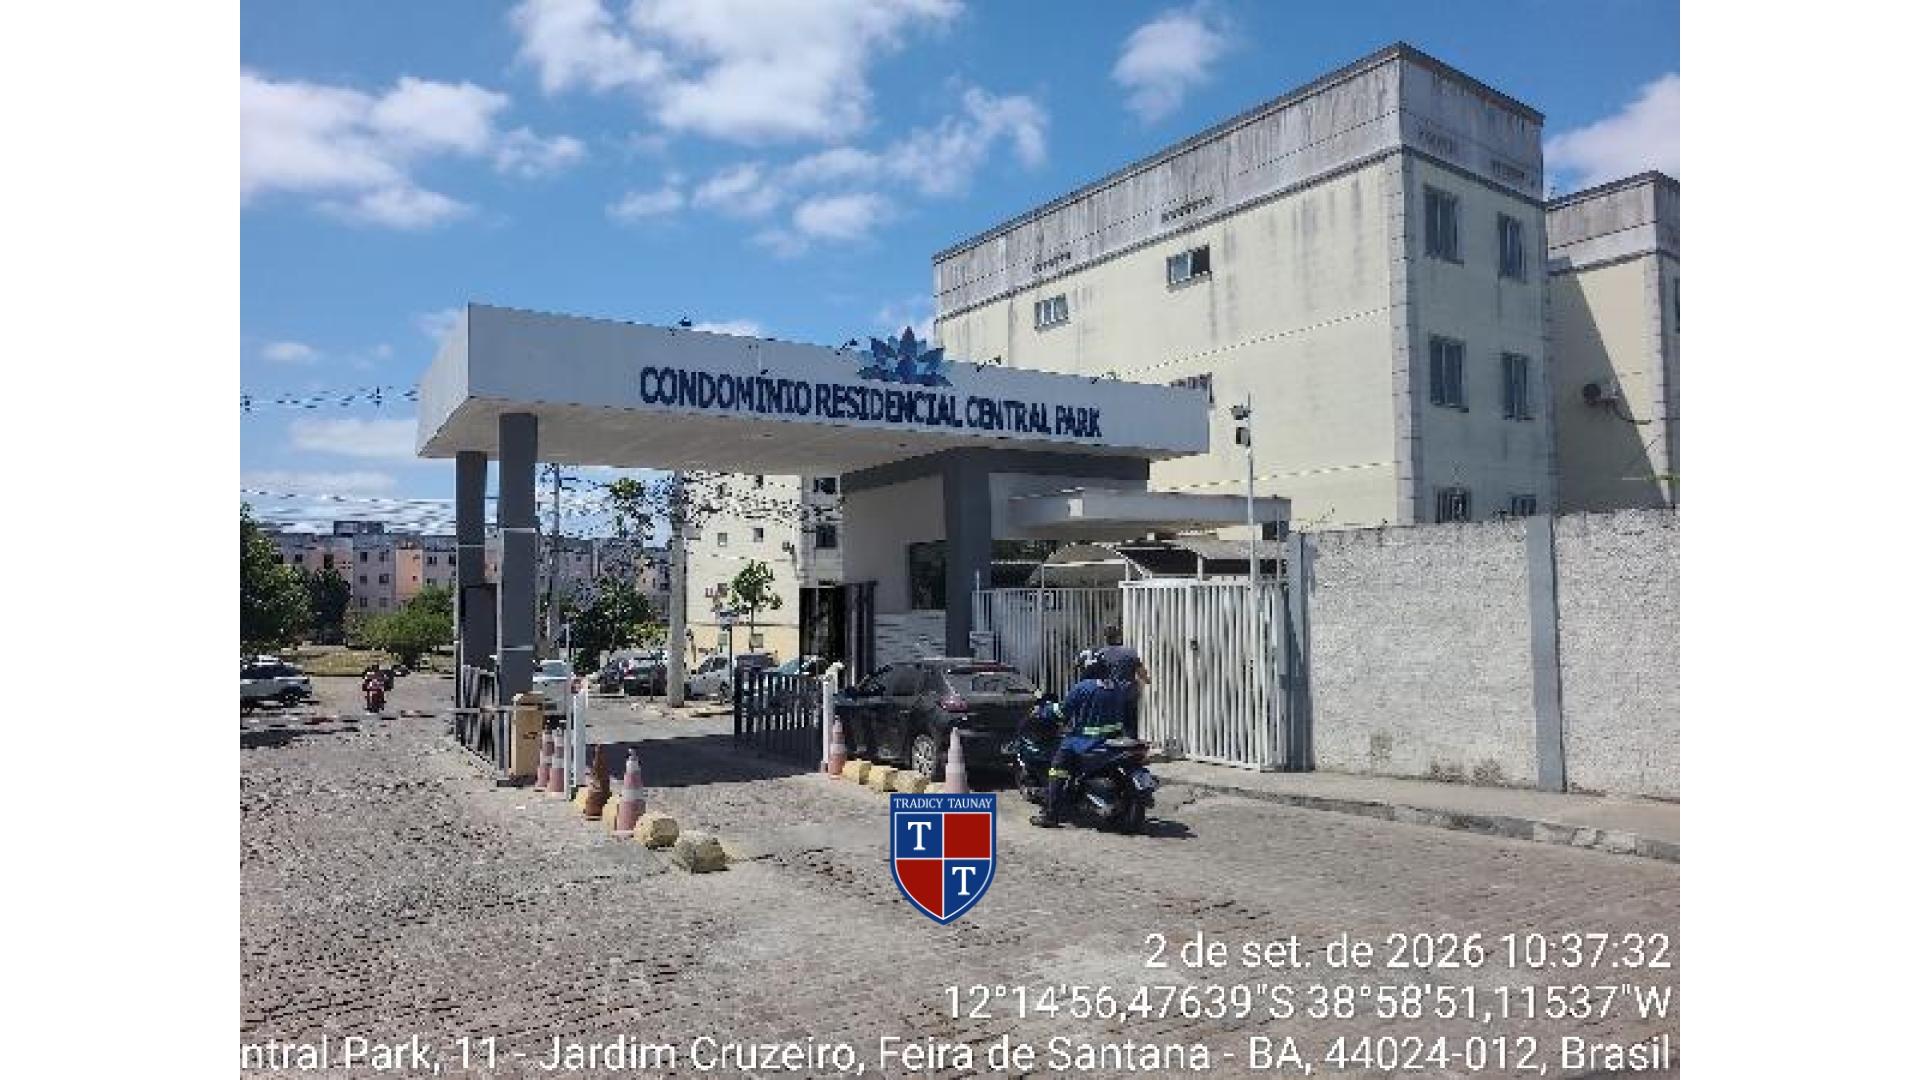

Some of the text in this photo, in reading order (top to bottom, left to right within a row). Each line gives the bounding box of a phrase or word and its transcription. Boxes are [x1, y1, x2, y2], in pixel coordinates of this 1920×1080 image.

[640, 366, 1103, 438] CONDOMÍNIO RESIDENCIAL CENTRAL PARK
